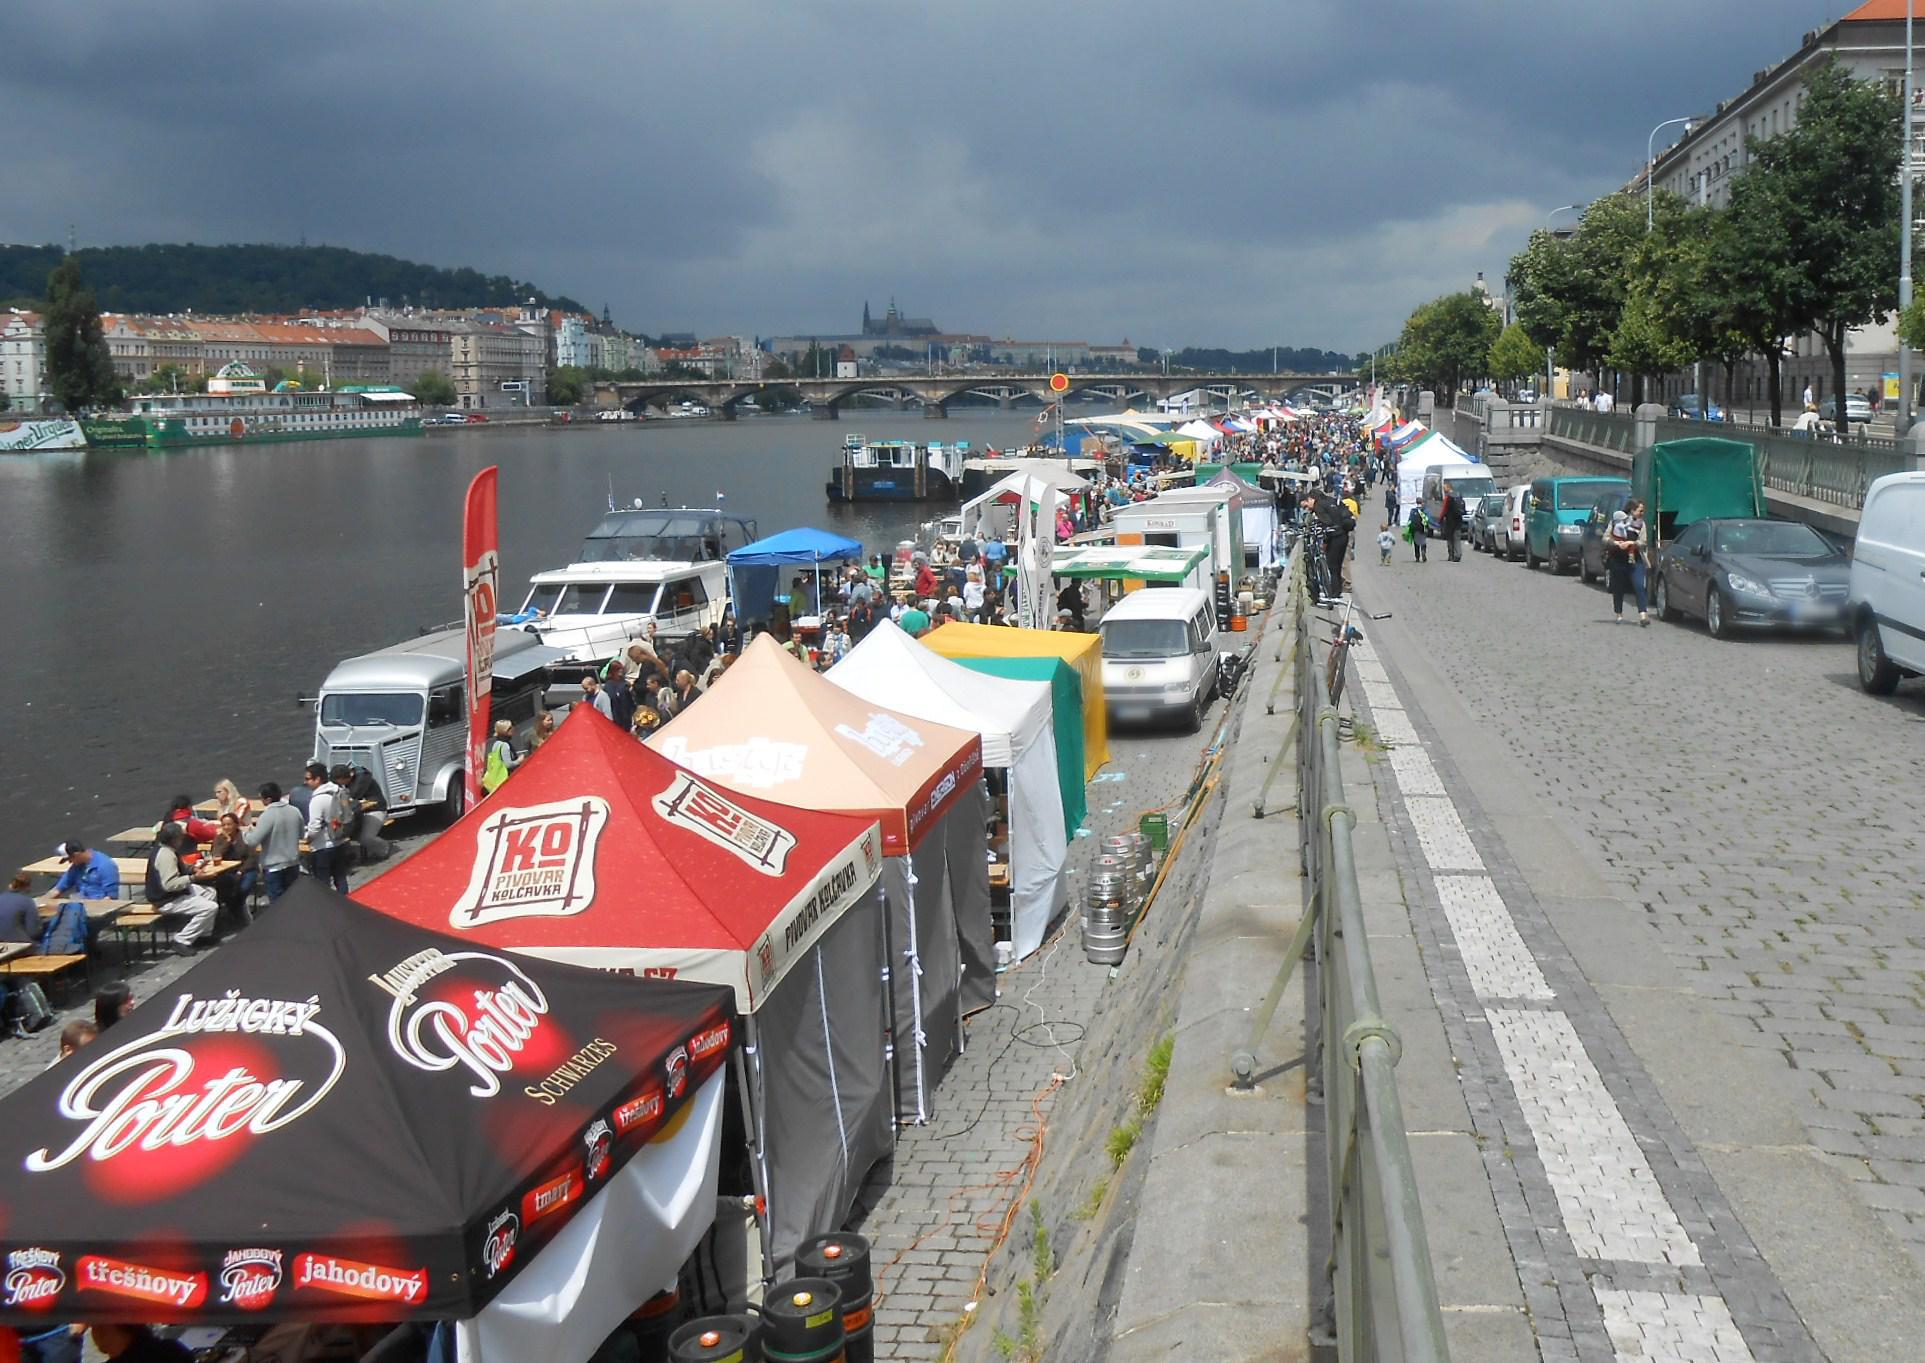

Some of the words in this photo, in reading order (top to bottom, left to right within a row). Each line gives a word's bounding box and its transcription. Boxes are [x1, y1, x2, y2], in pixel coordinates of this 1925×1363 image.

[685, 790, 742, 837] KO
[501, 822, 573, 873] KO
[495, 869, 565, 890] PIVOVAR
[784, 897, 819, 953] PIVOVAR
[161, 988, 322, 1036] LUŽICKÝ
[404, 979, 549, 1098] Porter
[524, 1037, 617, 1106] SCHWARZES
[25, 1046, 322, 1173] Porter
[5, 1270, 62, 1305] Porter
[87, 1260, 198, 1306] třešňový
[220, 1268, 280, 1302] Porter
[300, 1255, 422, 1301] jahodový
